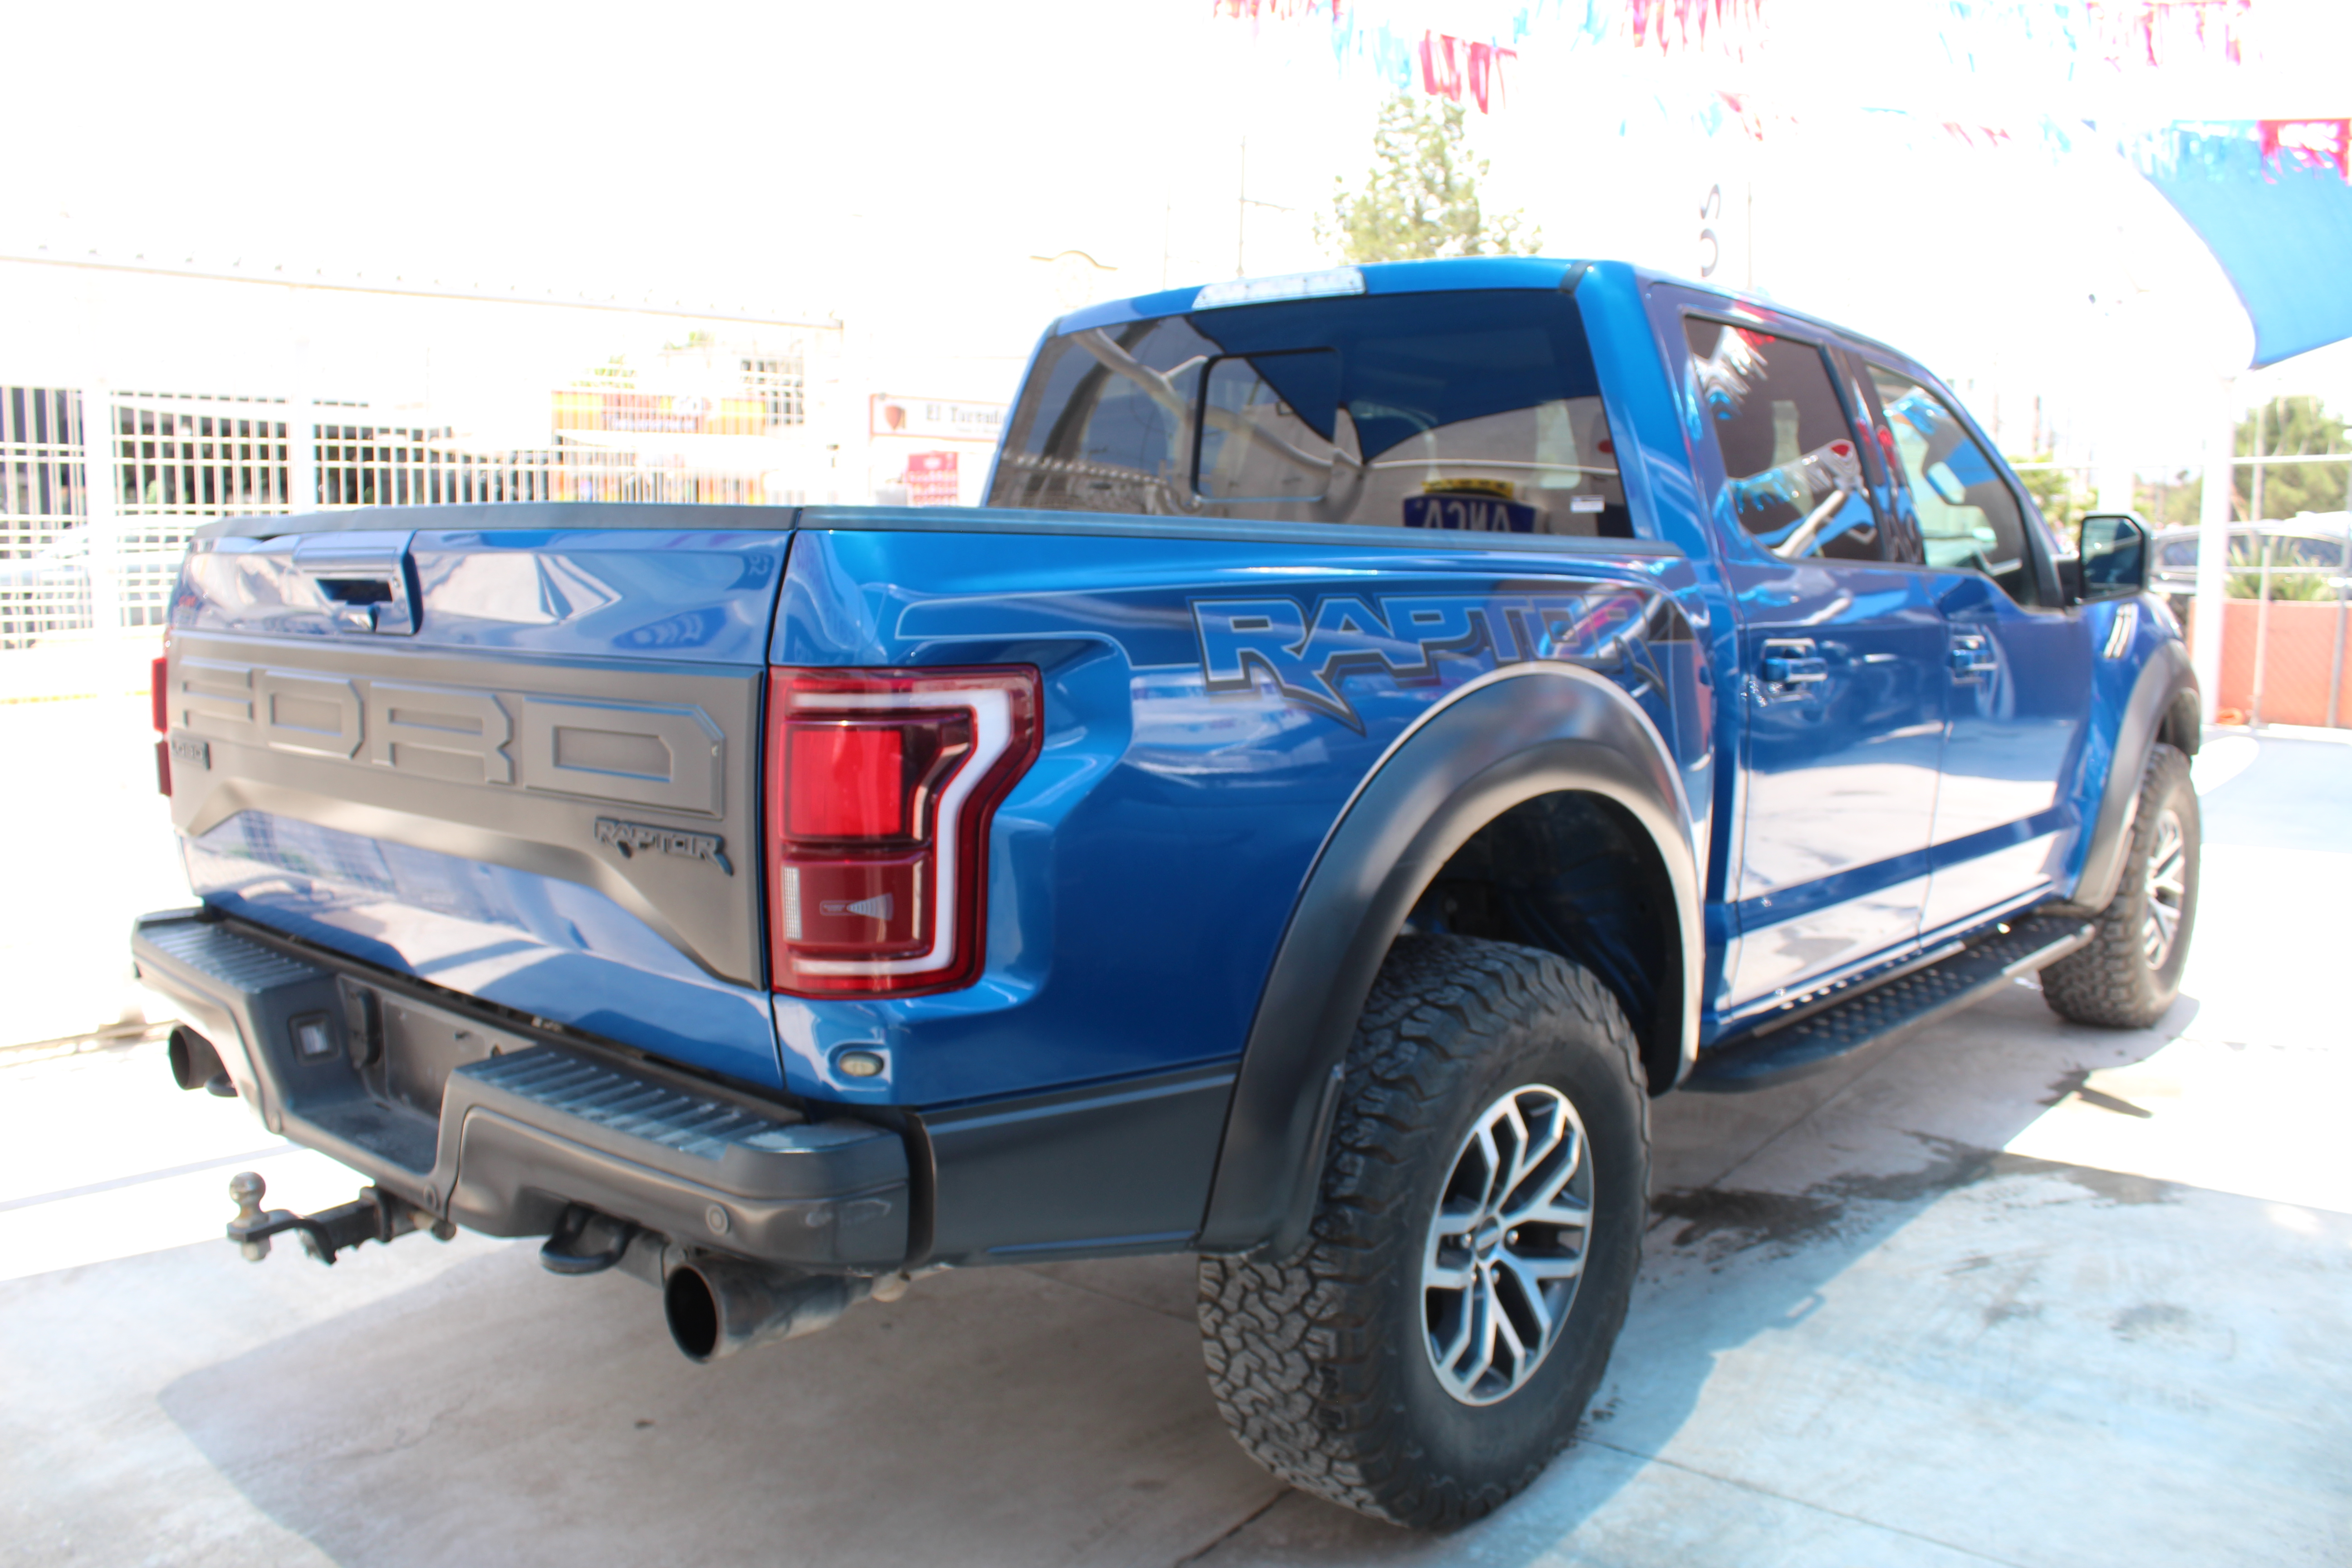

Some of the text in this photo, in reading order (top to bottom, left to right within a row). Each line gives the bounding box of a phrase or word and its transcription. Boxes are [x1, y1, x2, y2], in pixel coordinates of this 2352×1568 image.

[926, 403, 941, 421] El
[1188, 595, 1671, 736] RAPTOR
[172, 657, 725, 819] FORD
[594, 816, 733, 877] RAPTOR
